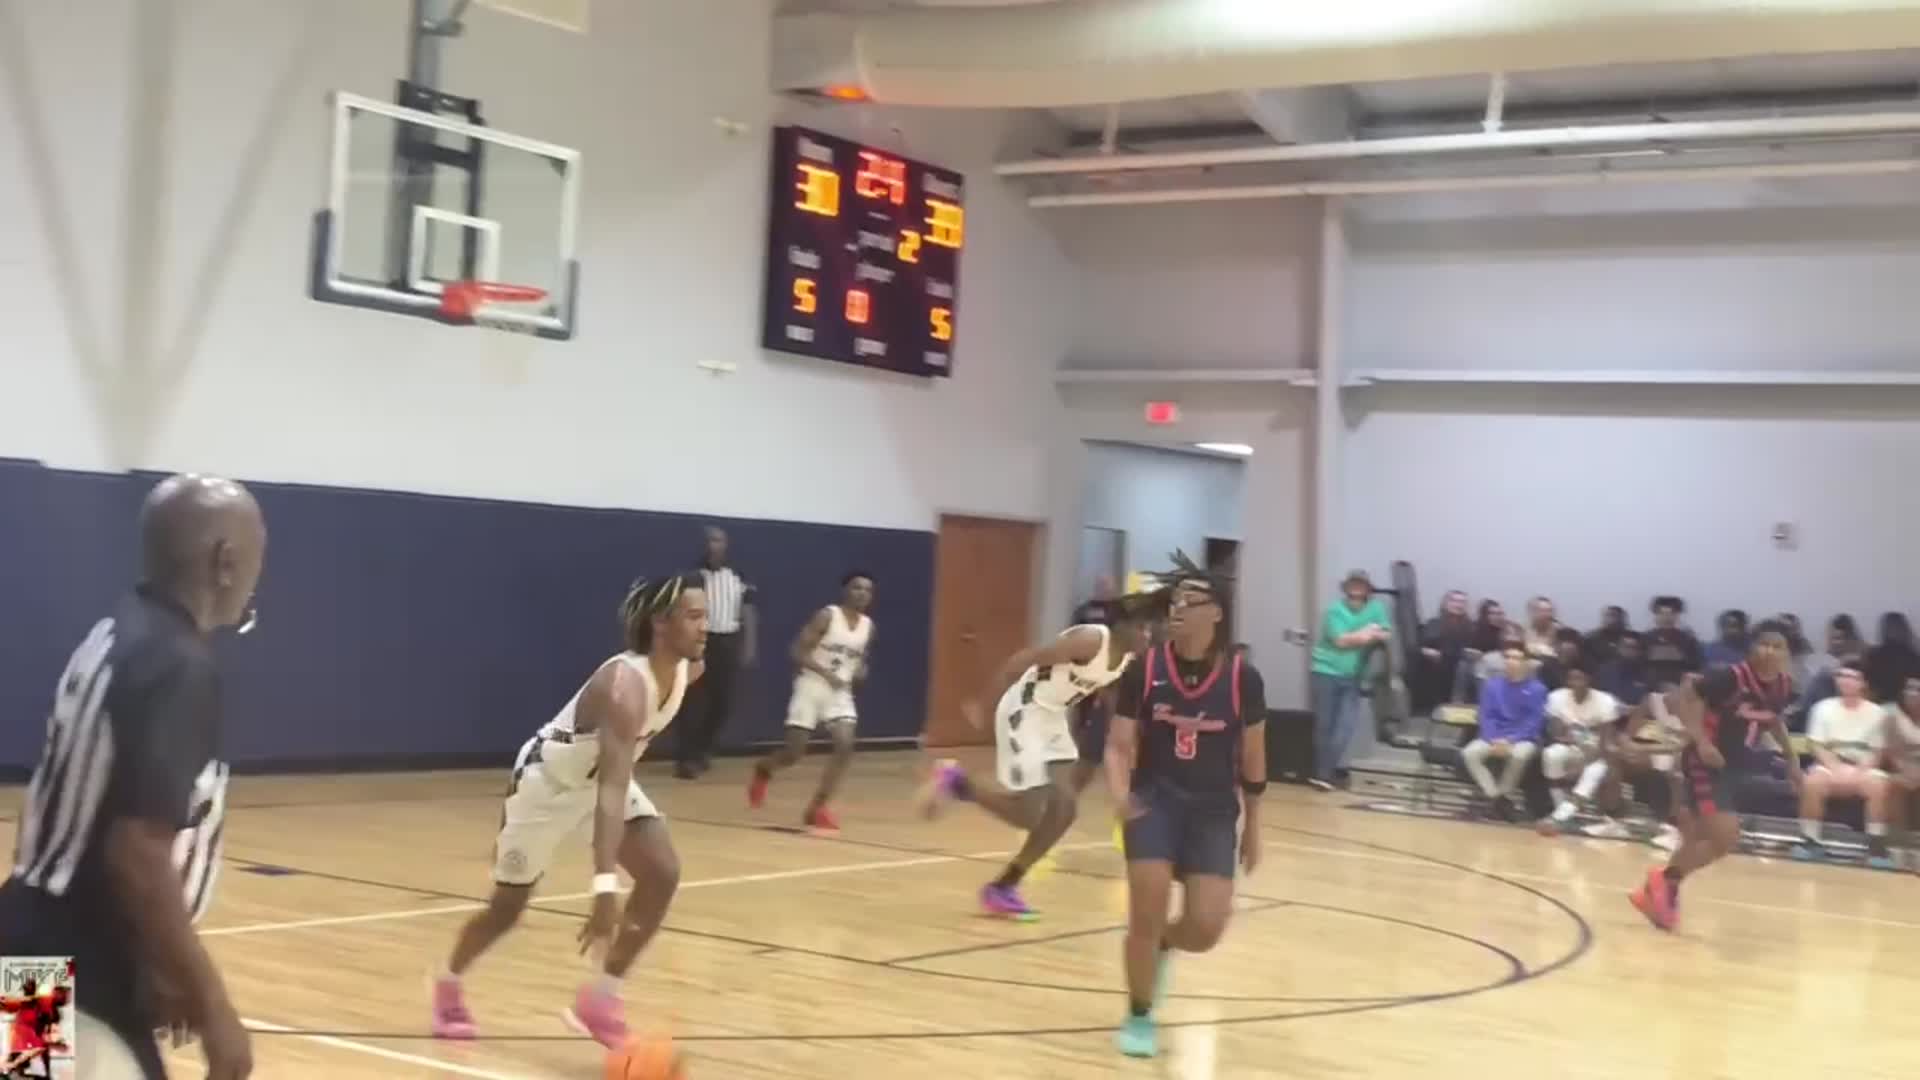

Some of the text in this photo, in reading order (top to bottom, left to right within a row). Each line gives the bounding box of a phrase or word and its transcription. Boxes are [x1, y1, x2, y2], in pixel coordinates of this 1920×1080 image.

[898, 229, 921, 263] 2
[793, 277, 817, 313] 5
[929, 307, 951, 341] 5
